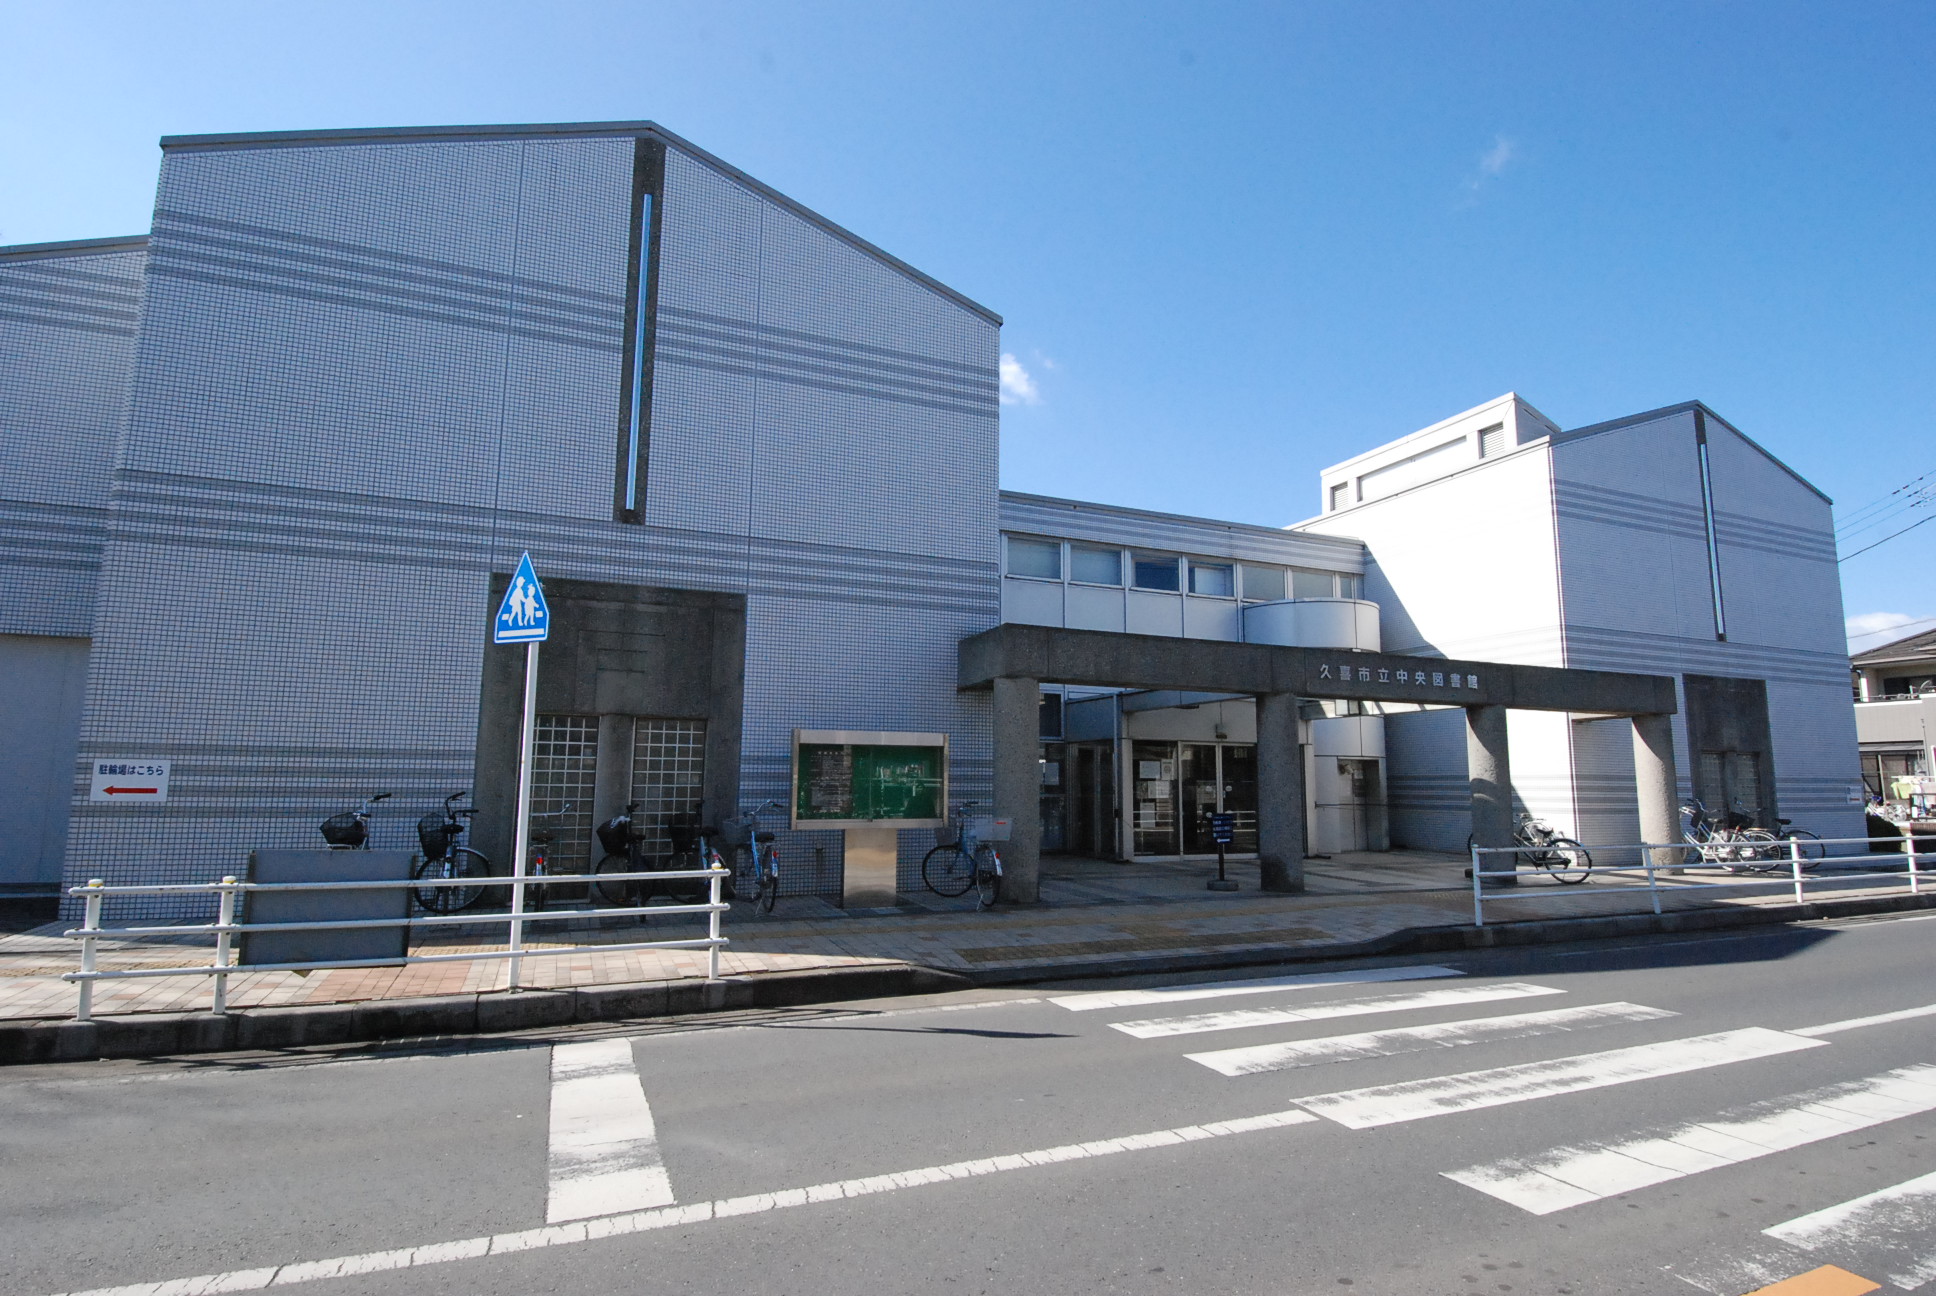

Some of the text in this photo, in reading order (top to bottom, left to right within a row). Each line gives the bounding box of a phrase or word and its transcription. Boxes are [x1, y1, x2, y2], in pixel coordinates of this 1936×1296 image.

[1319, 663, 1478, 689] 久喜市立中央図書館
[98, 764, 164, 775] 駐輪場はこちら
